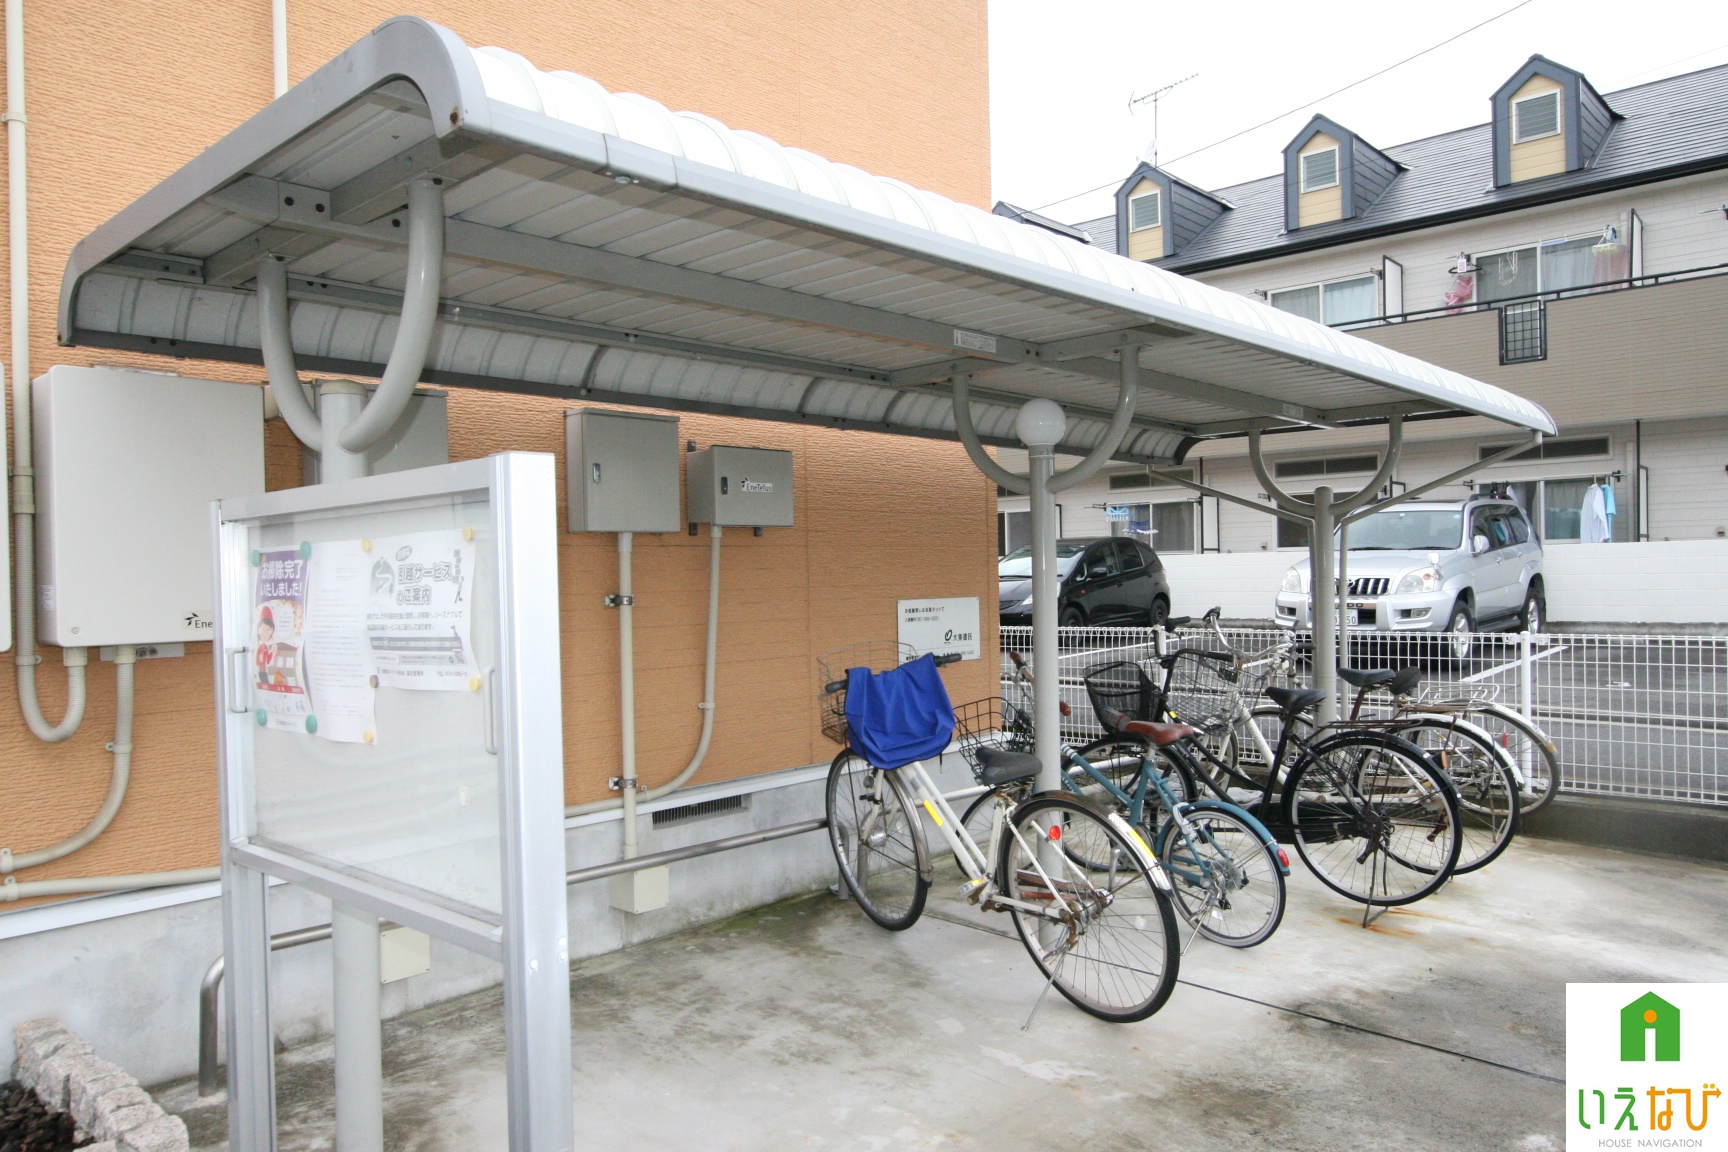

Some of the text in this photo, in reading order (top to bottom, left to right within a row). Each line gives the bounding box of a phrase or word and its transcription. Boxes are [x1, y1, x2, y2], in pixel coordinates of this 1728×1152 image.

[746, 483, 772, 492] EneTelus
[261, 559, 304, 580] お掃除完了
[397, 561, 453, 584] 引越サービス
[395, 584, 433, 606] のご案内
